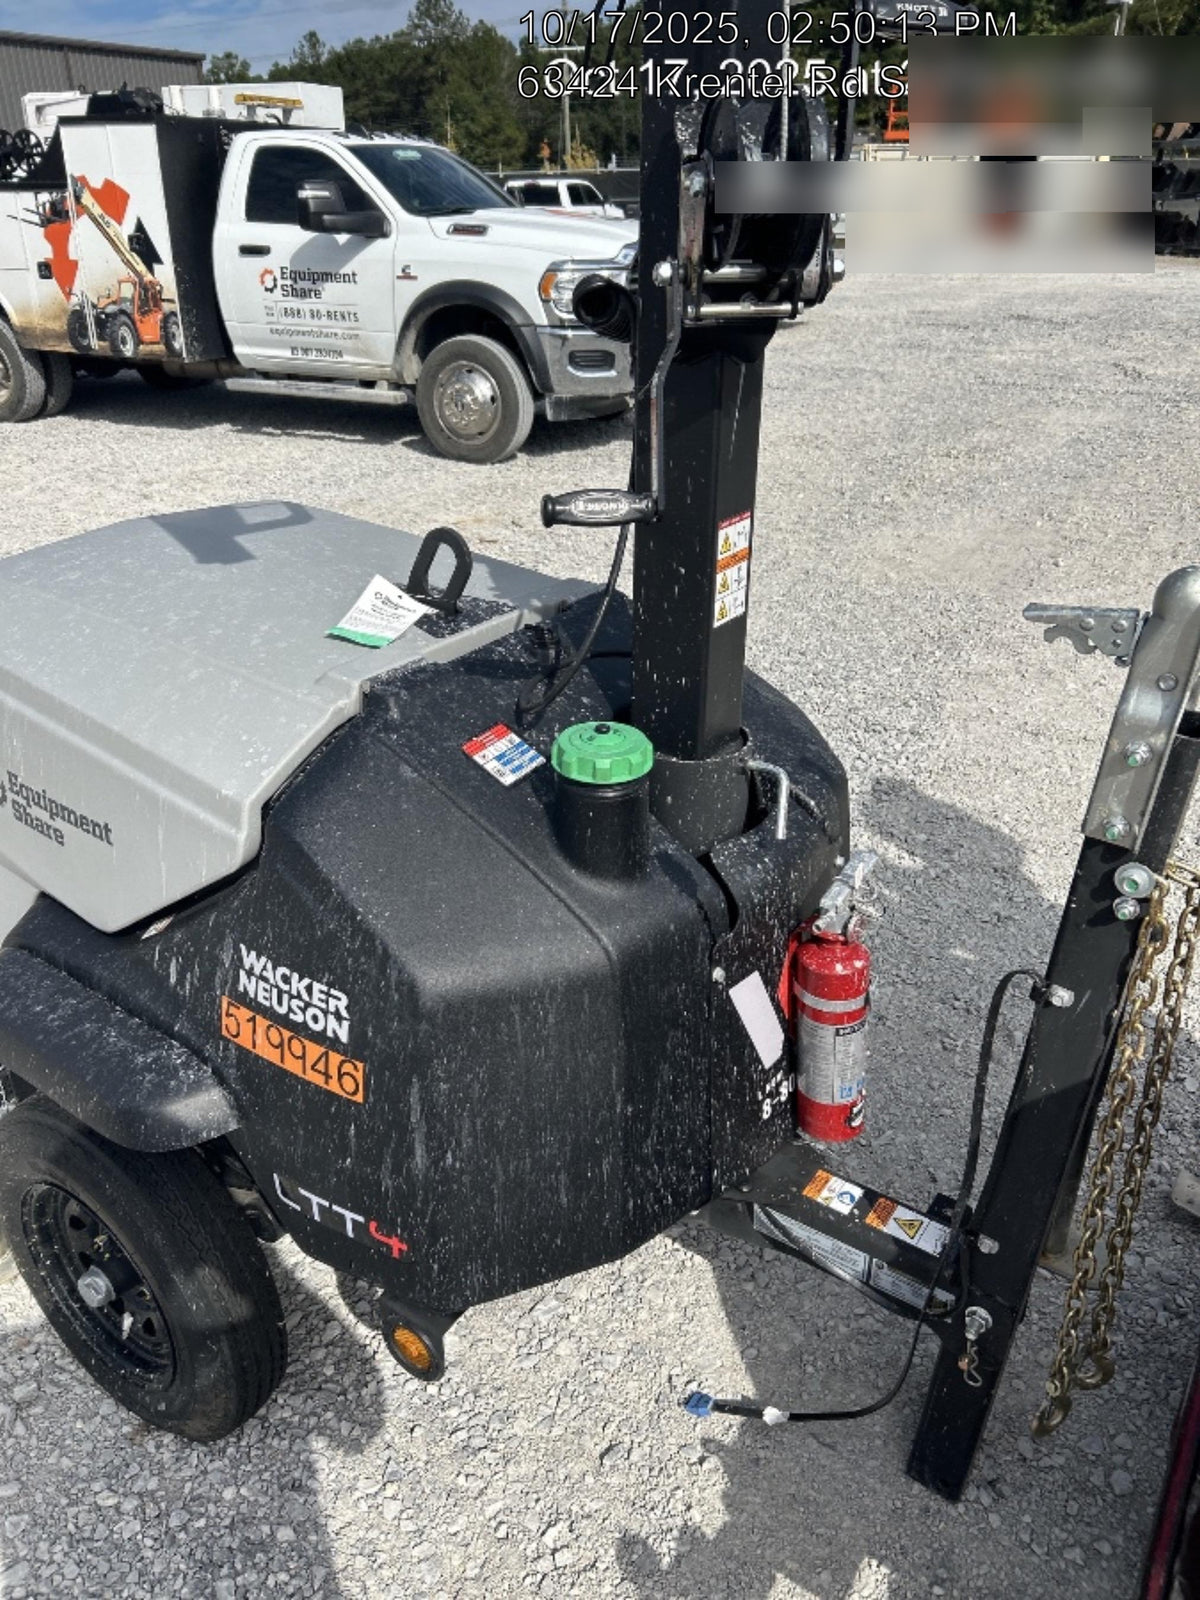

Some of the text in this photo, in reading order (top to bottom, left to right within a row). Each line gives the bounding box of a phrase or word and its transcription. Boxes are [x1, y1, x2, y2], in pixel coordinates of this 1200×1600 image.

[279, 266, 358, 285] Equipment
[281, 284, 323, 300] Share
[6, 769, 114, 847] Equipment
[11, 798, 65, 847] Share
[238, 968, 350, 1044] NEUSON
[239, 943, 350, 1020] WACKER
[224, 1001, 361, 1098] 519946
[272, 1172, 408, 1259] LTT4
